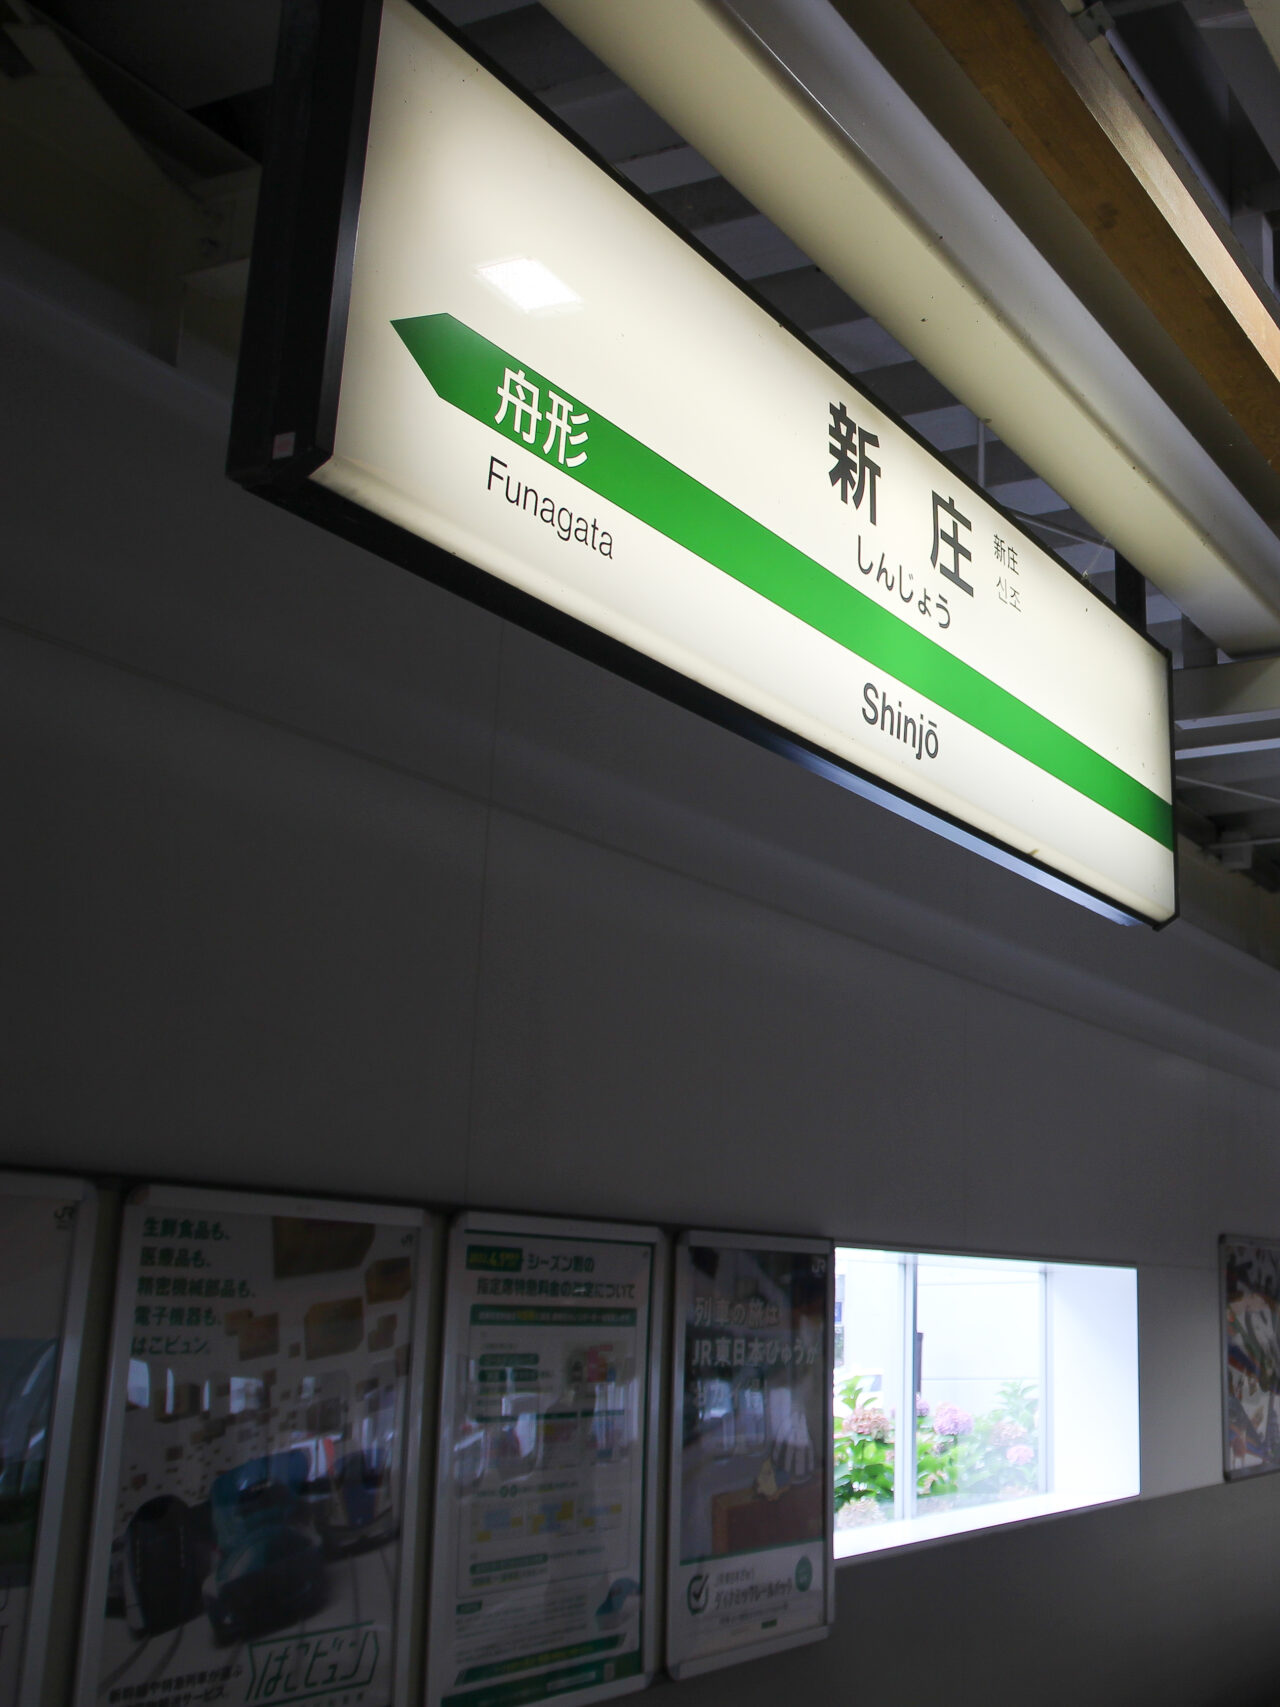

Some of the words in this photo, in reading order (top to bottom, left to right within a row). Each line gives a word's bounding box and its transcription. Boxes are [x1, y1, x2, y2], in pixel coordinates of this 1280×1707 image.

[494, 367, 591, 469] 舟形
[486, 455, 614, 560] Funagata
[828, 401, 975, 598] 新庄
[856, 534, 952, 630] しんじょう
[994, 534, 1019, 575] 新庄
[996, 577, 1021, 612] 신조
[861, 681, 940, 760] Shinjō
